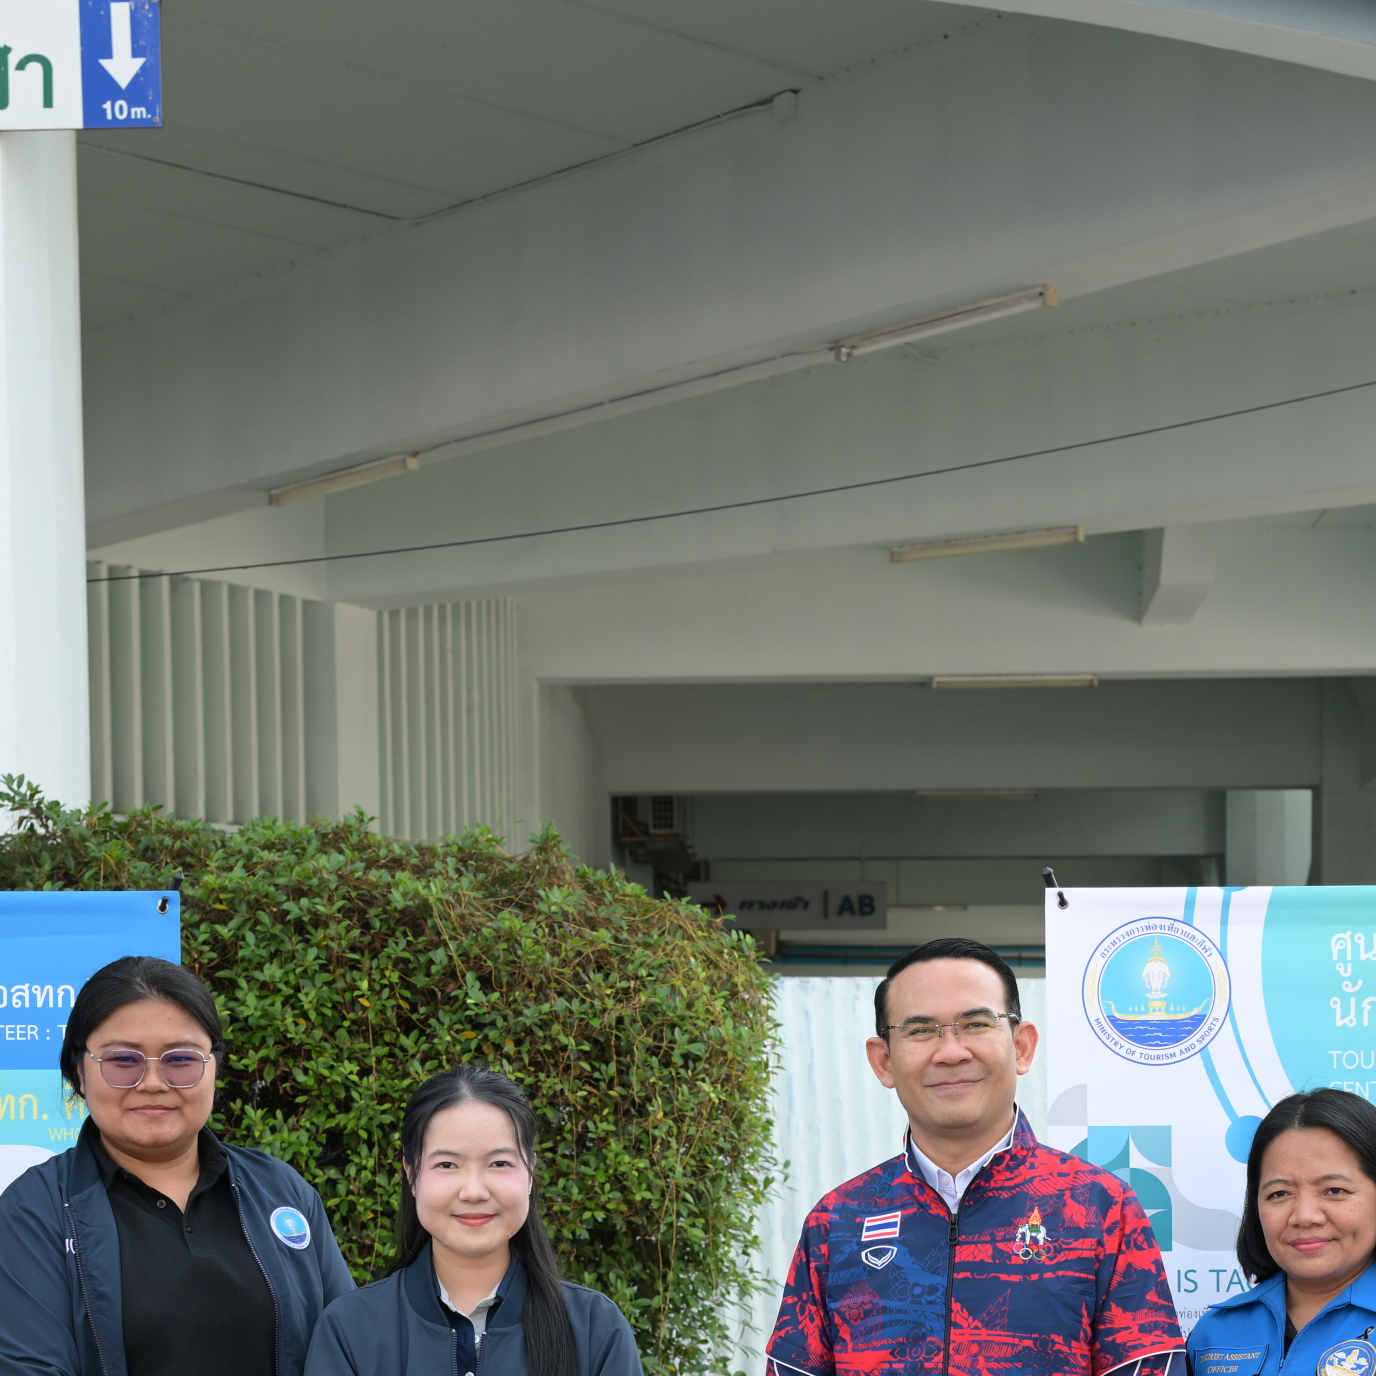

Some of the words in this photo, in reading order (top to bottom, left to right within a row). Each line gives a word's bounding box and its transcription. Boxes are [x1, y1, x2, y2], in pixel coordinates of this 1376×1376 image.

[837, 895, 876, 917] AB
[1094, 1017, 1125, 1051] MINISTRY
[1125, 1047, 1137, 1057] OF
[1139, 1051, 1177, 1061] TOURISM
[1179, 1043, 1197, 1056] AND
[1198, 1016, 1220, 1045] SPORTS
[1177, 1269, 1198, 1293] IS
[1224, 1352, 1261, 1361] ASSISTANT
[1207, 1366, 1239, 1374] OFFICER
